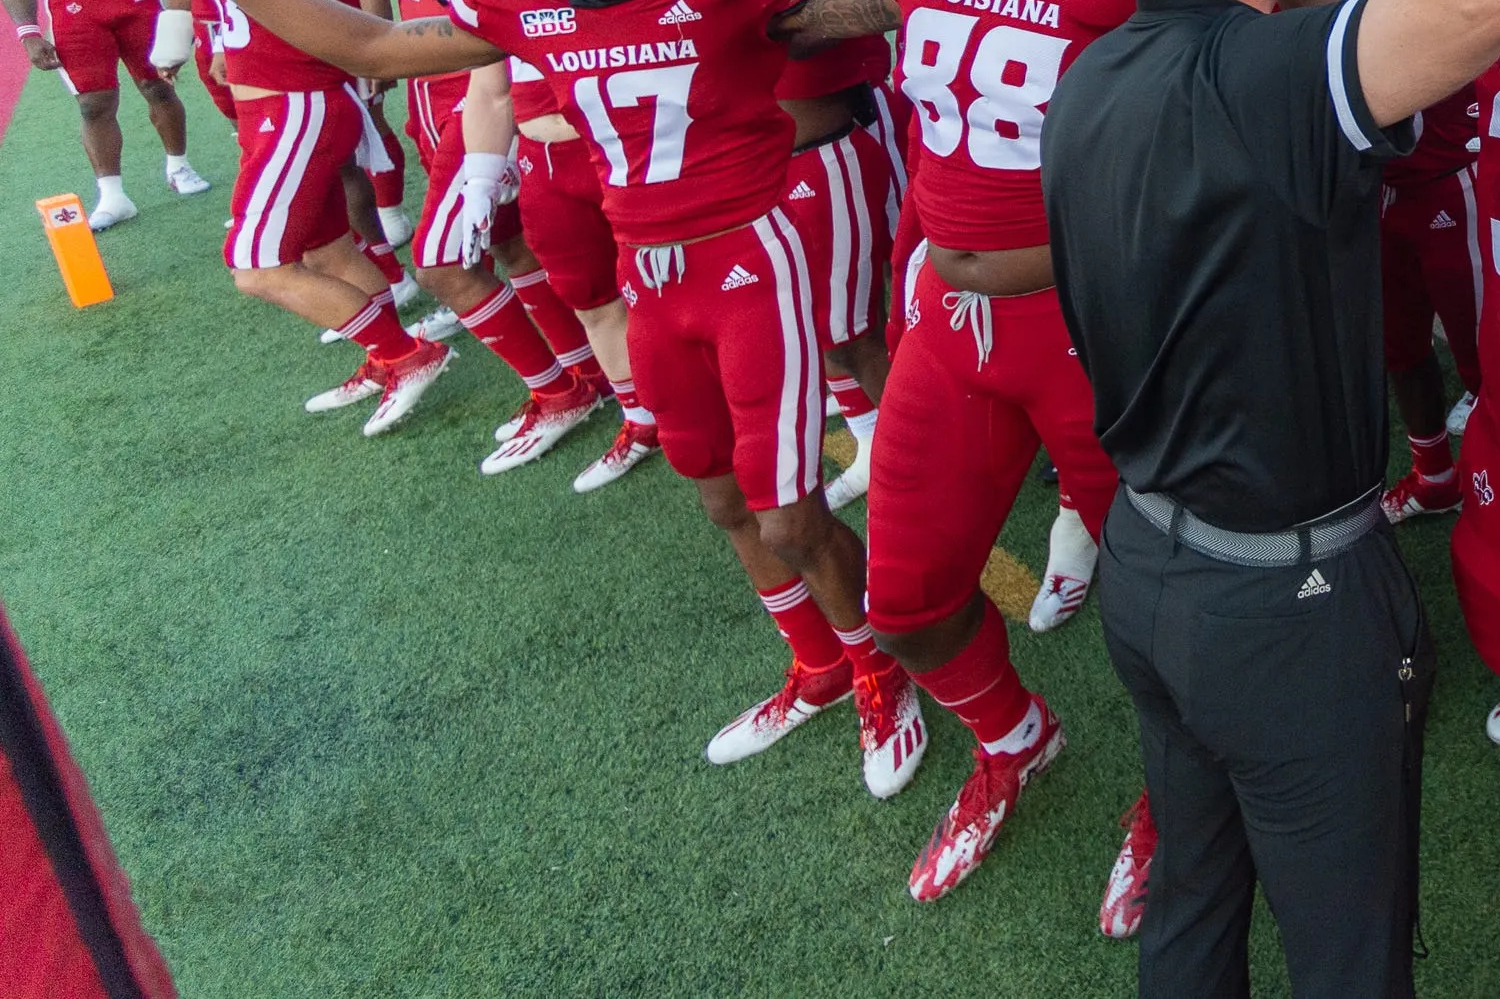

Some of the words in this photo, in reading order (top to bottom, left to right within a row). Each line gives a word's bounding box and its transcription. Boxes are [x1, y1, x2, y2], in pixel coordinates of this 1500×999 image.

[519, 7, 577, 38] SBC
[658, 10, 703, 26] adidas
[545, 38, 700, 73] LOUISIANA
[900, 6, 1073, 170] 88
[573, 61, 700, 188] 17
[721, 273, 760, 292] adidas
[1296, 582, 1333, 600] adidas
